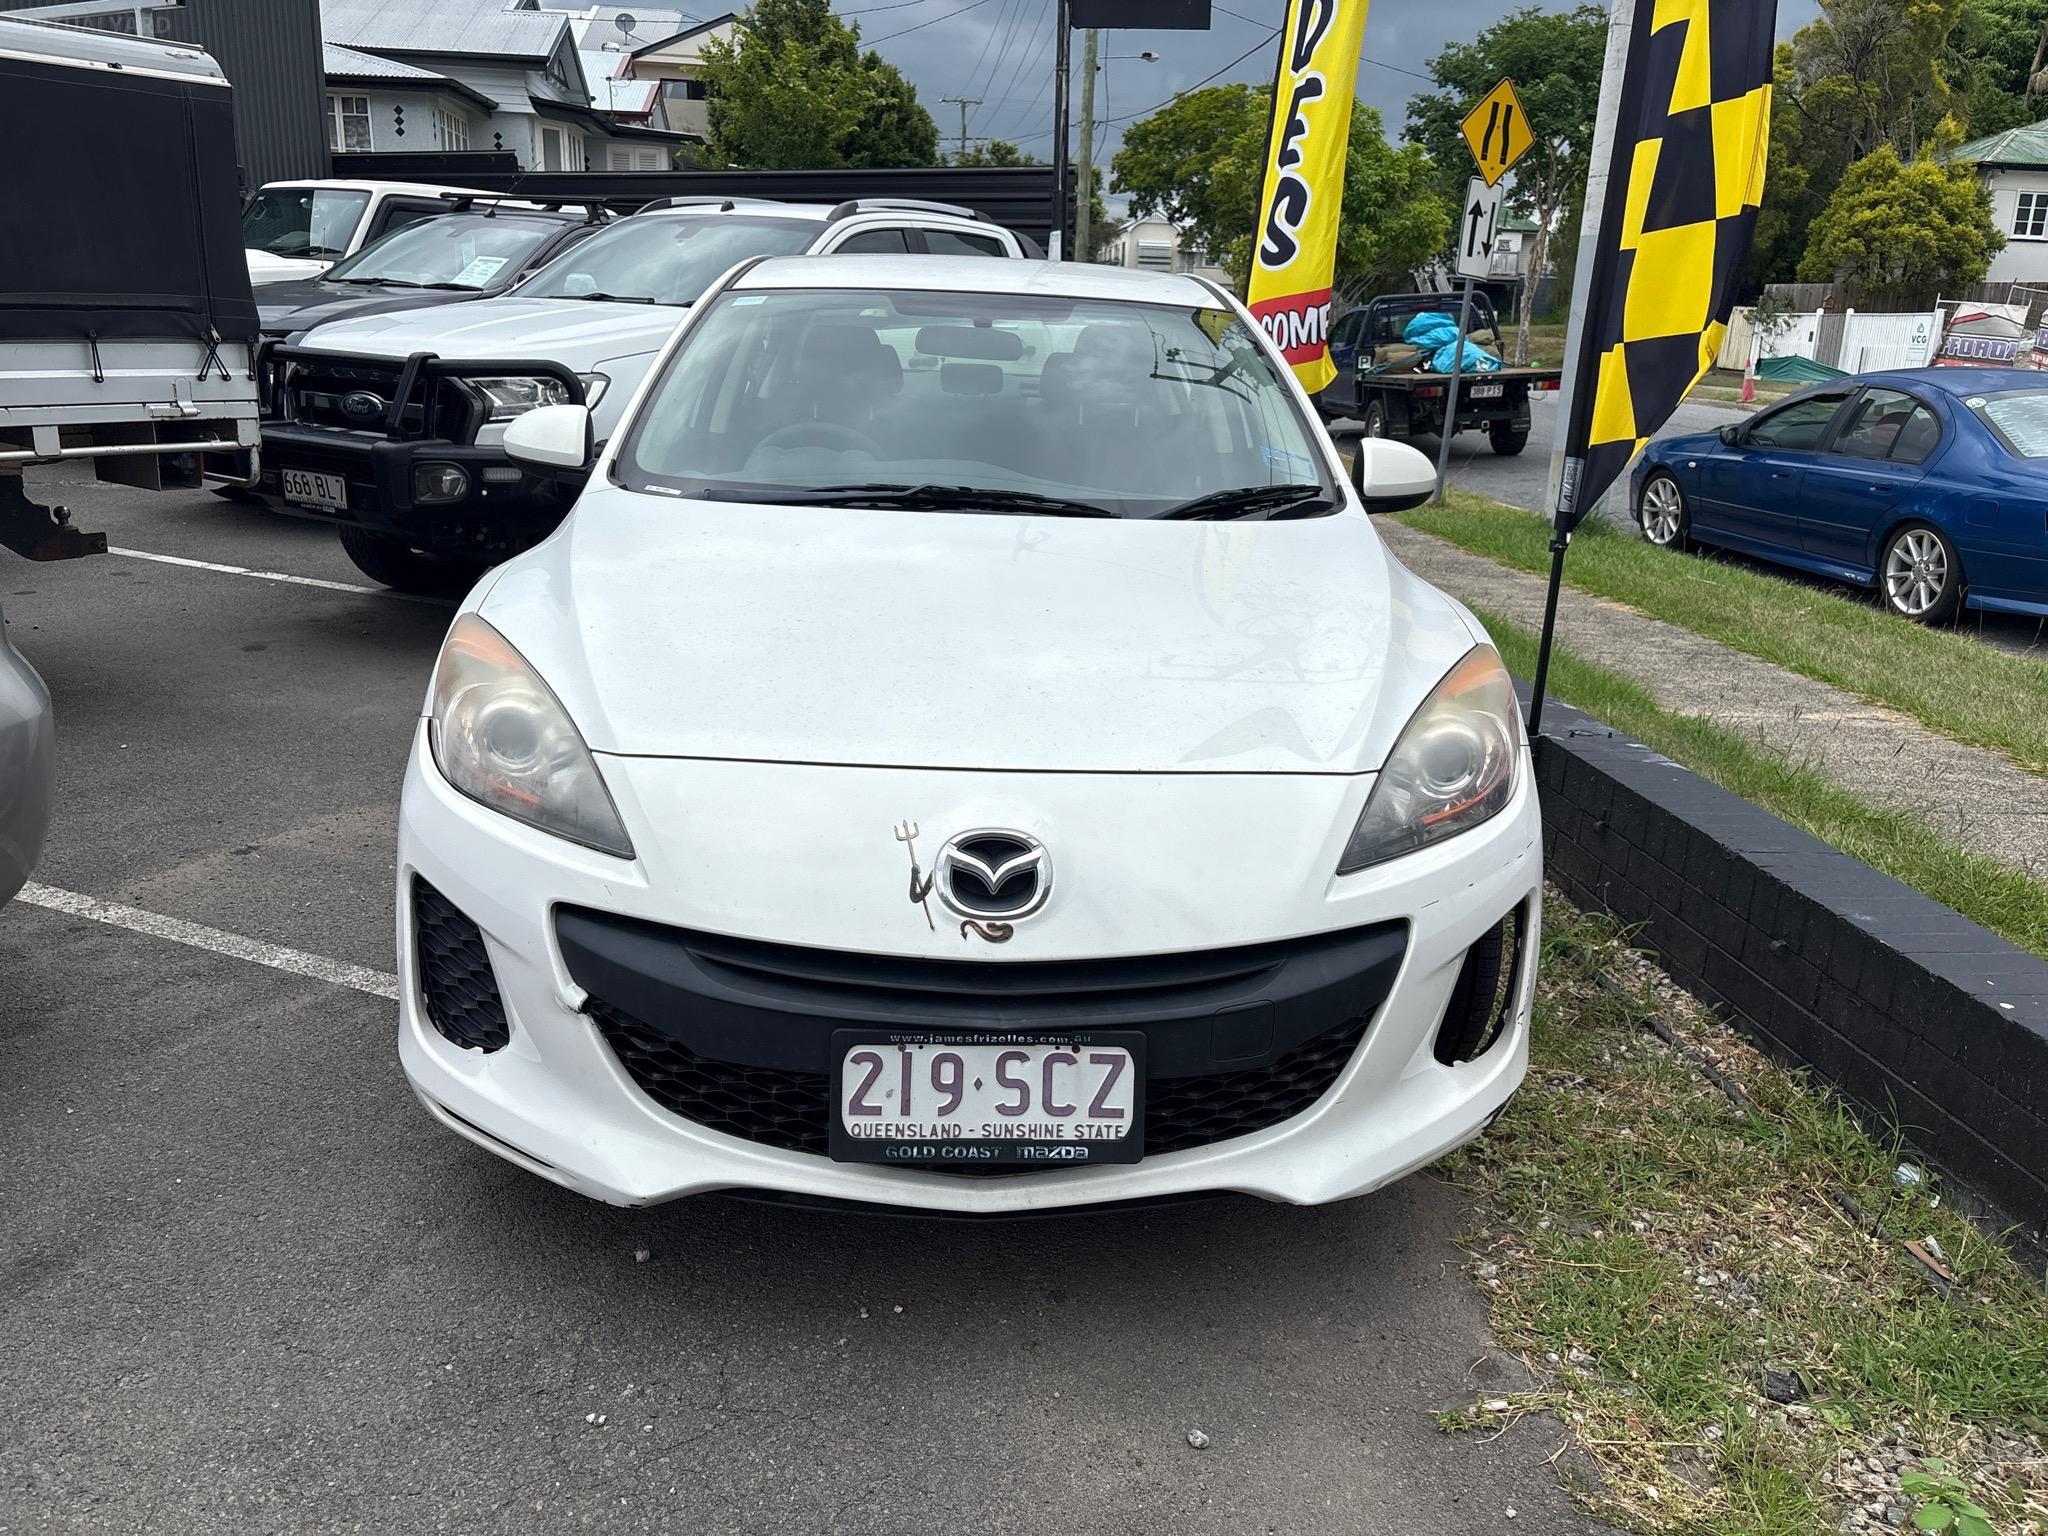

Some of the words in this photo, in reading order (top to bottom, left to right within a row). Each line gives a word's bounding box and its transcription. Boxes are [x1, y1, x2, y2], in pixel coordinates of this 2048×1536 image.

[1911, 335, 1927, 344] VCG
[1360, 357, 1369, 368] P
[346, 397, 370, 414] Ford
[890, 1033, 1091, 1045] www.jamesfrizelles.com.au
[851, 1123, 962, 1138] QUEENSLAND
[981, 1123, 1064, 1138] SUNSHINE
[1074, 1124, 1124, 1139] STATE
[886, 1145, 936, 1159] GOLD
[941, 1145, 1001, 1159] COAST
